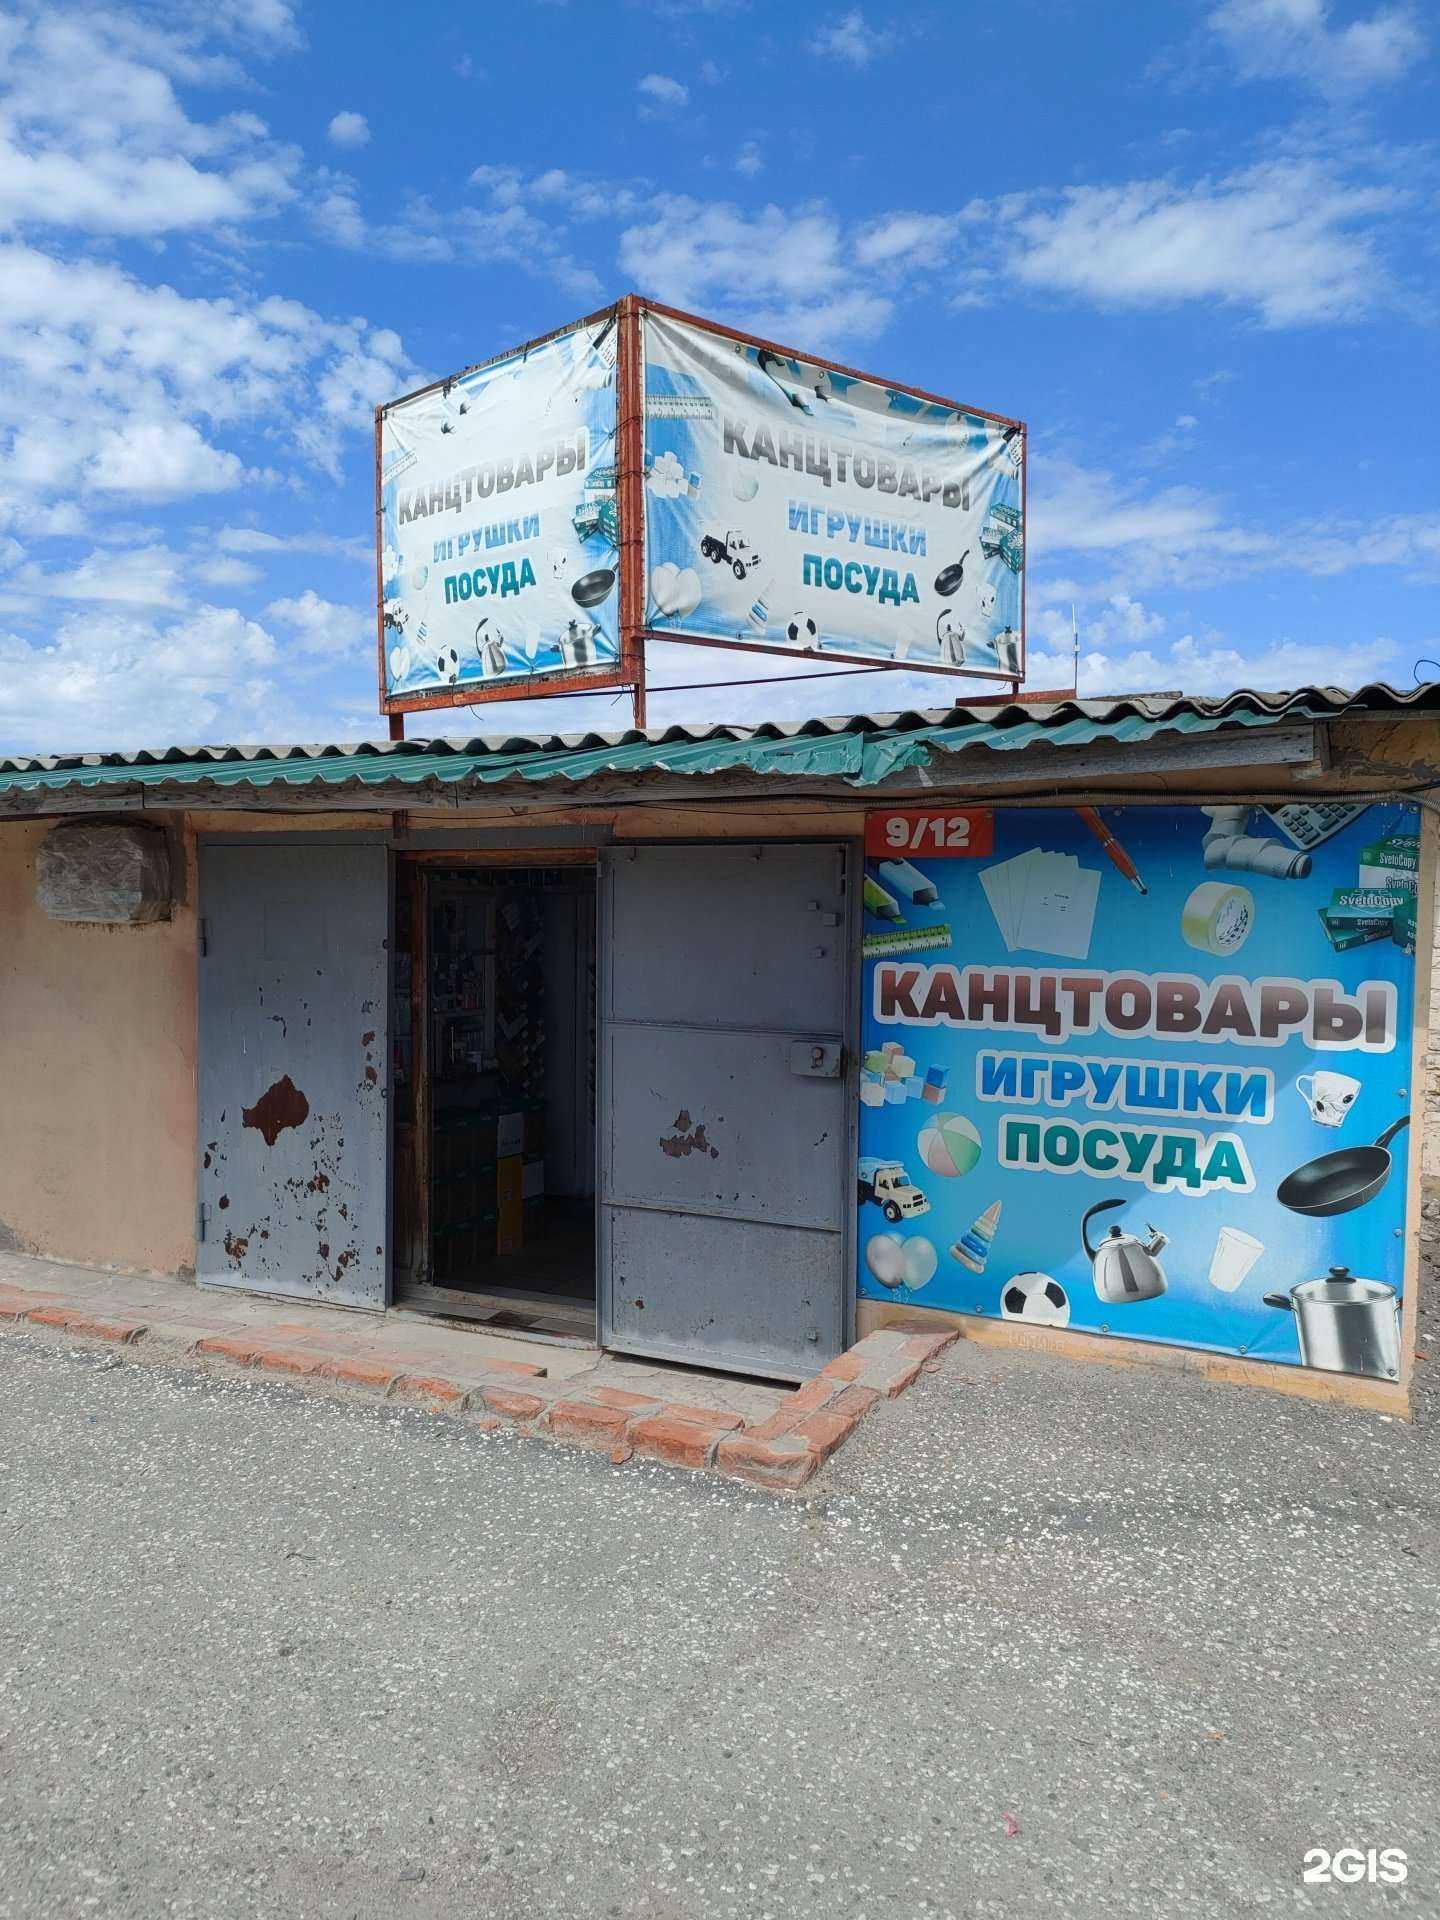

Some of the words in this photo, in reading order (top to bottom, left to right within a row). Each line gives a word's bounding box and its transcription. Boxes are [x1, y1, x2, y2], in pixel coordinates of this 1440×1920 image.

[399, 435, 586, 525] КАНЦТОВАРЫ
[723, 417, 970, 511] КАНЦТОВАРЫ
[433, 512, 541, 563] ИГРУШКИ
[788, 501, 927, 556] ИГРУШКИ
[445, 558, 537, 604] ПОСУДА
[803, 554, 920, 606] ПОСУДА
[886, 816, 970, 849] 9/12
[1339, 895, 1404, 907] SvetoCopy
[880, 969, 1388, 1045] КАНЦТОВАРЫ
[982, 1055, 1267, 1118] ИГРУШКИ
[1005, 1121, 1247, 1189] ПОСУДА
